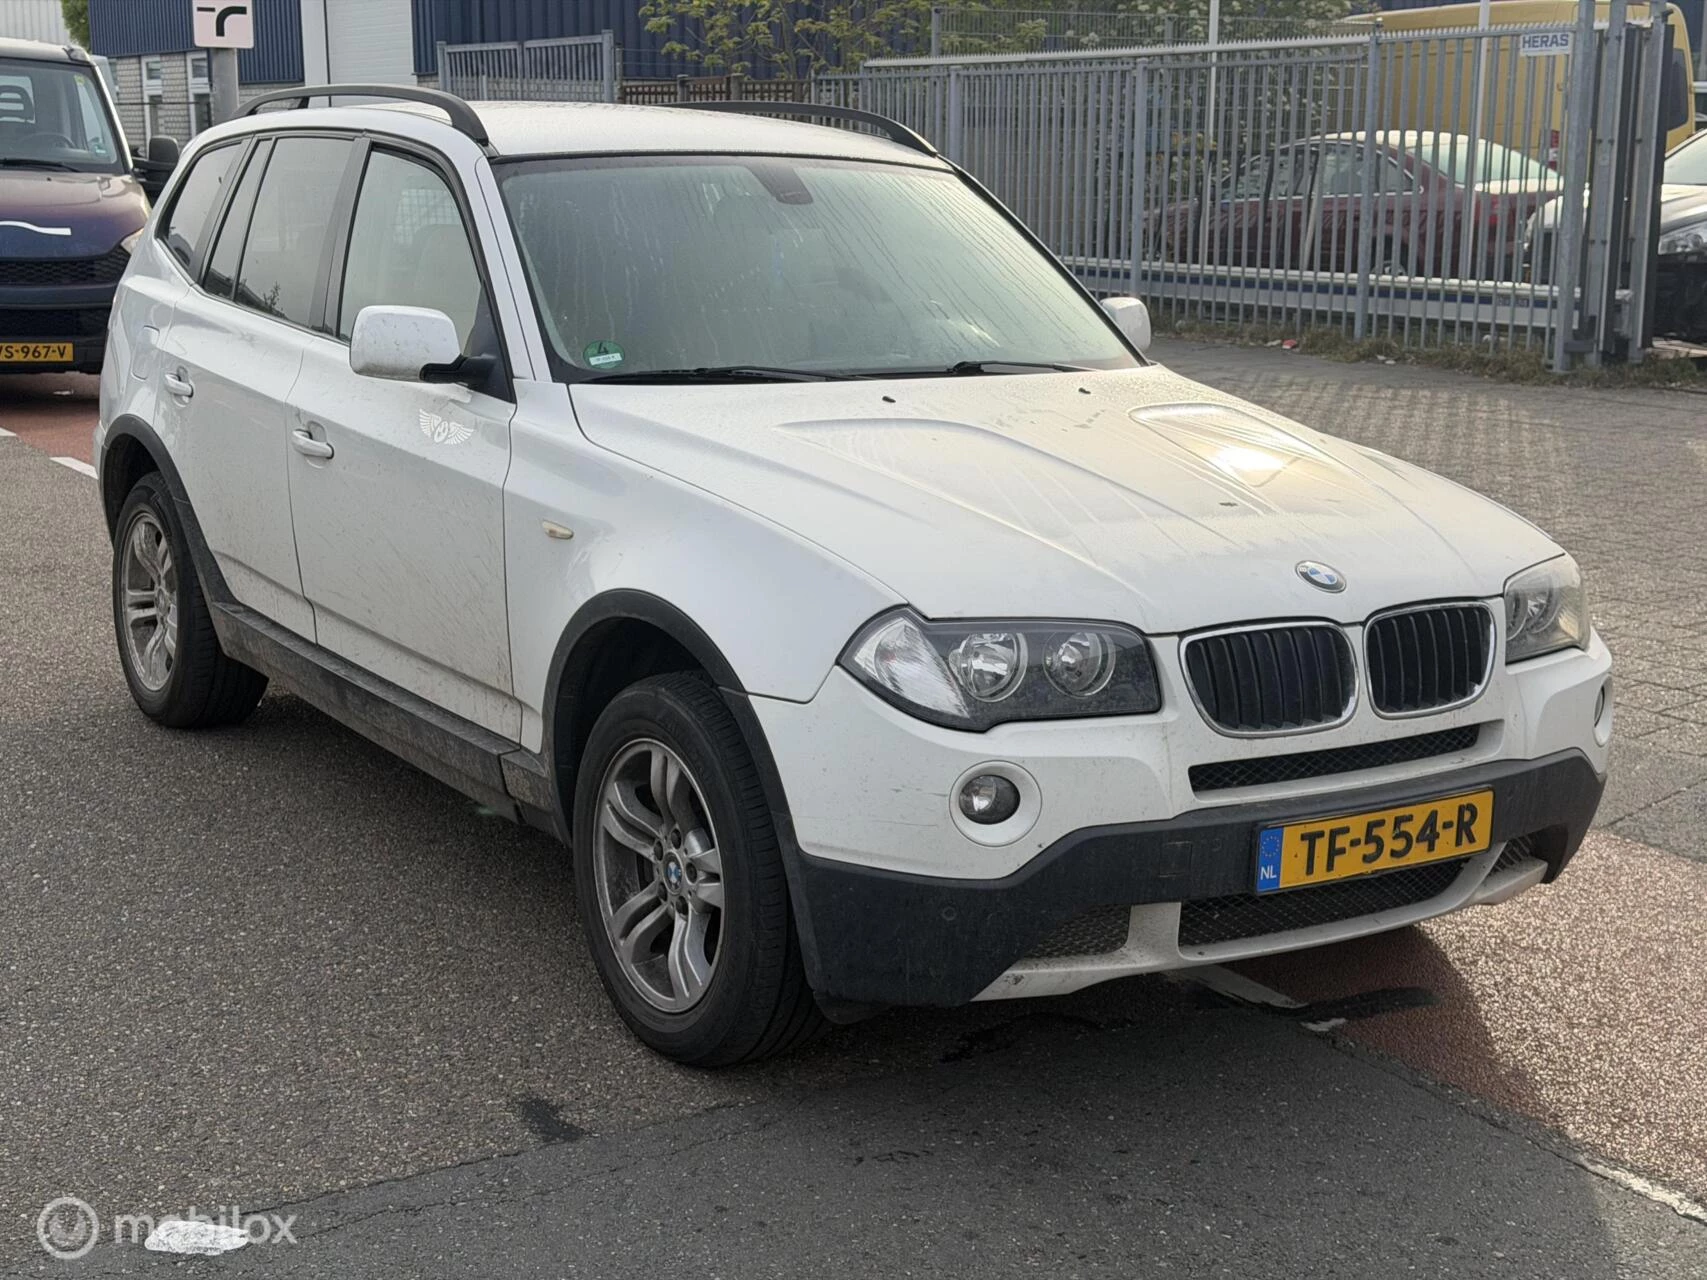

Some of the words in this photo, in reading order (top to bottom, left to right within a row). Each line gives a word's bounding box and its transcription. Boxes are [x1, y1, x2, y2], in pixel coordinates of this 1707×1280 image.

[1522, 33, 1569, 49] HERAS
[1300, 803, 1478, 876] TF-554-R
[1260, 865, 1277, 880] NL
